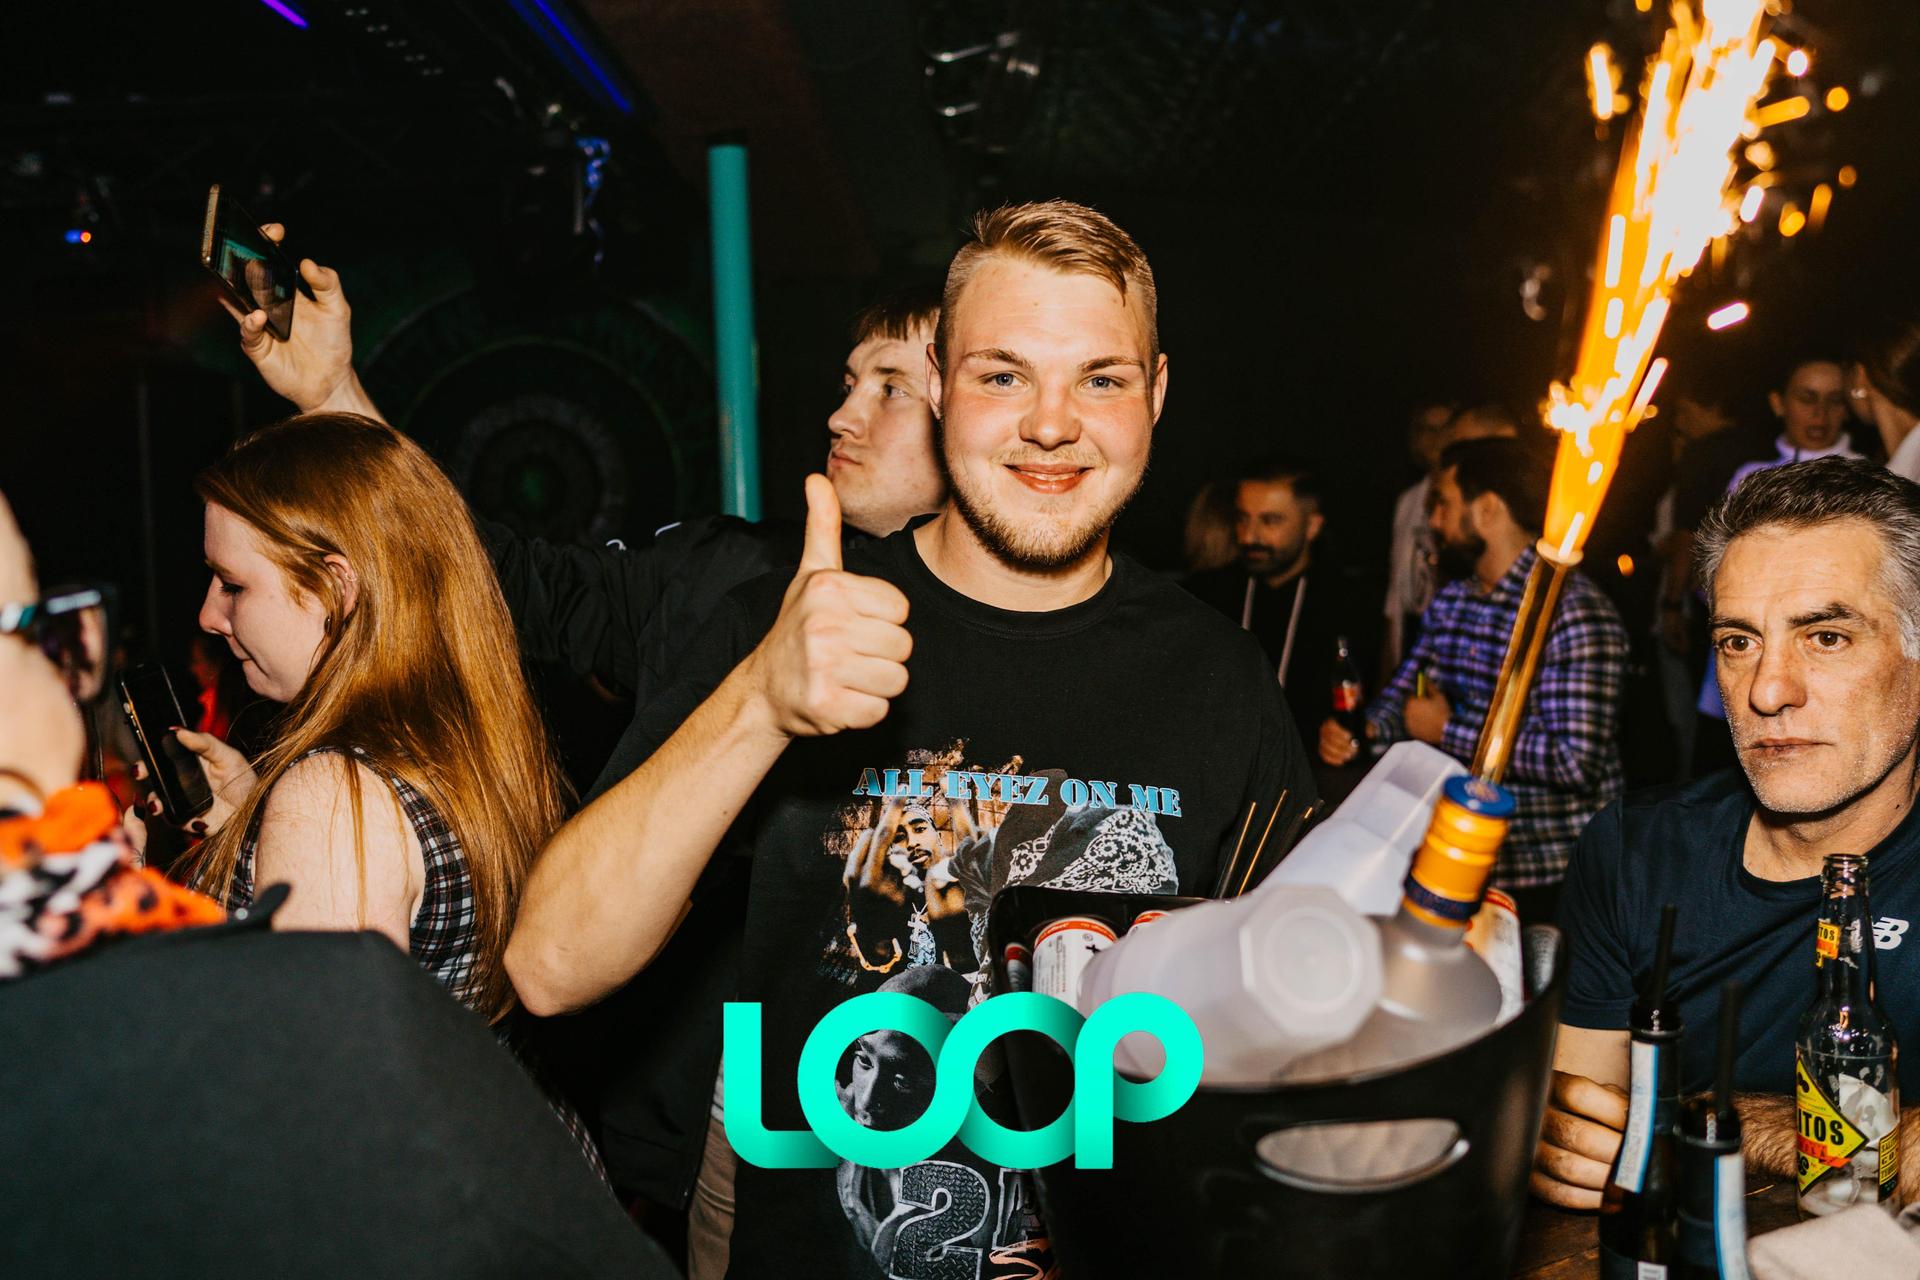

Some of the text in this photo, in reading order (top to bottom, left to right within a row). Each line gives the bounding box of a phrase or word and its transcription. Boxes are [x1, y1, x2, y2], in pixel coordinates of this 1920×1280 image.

[853, 768, 1183, 818] ALL EYEZ ON ME
